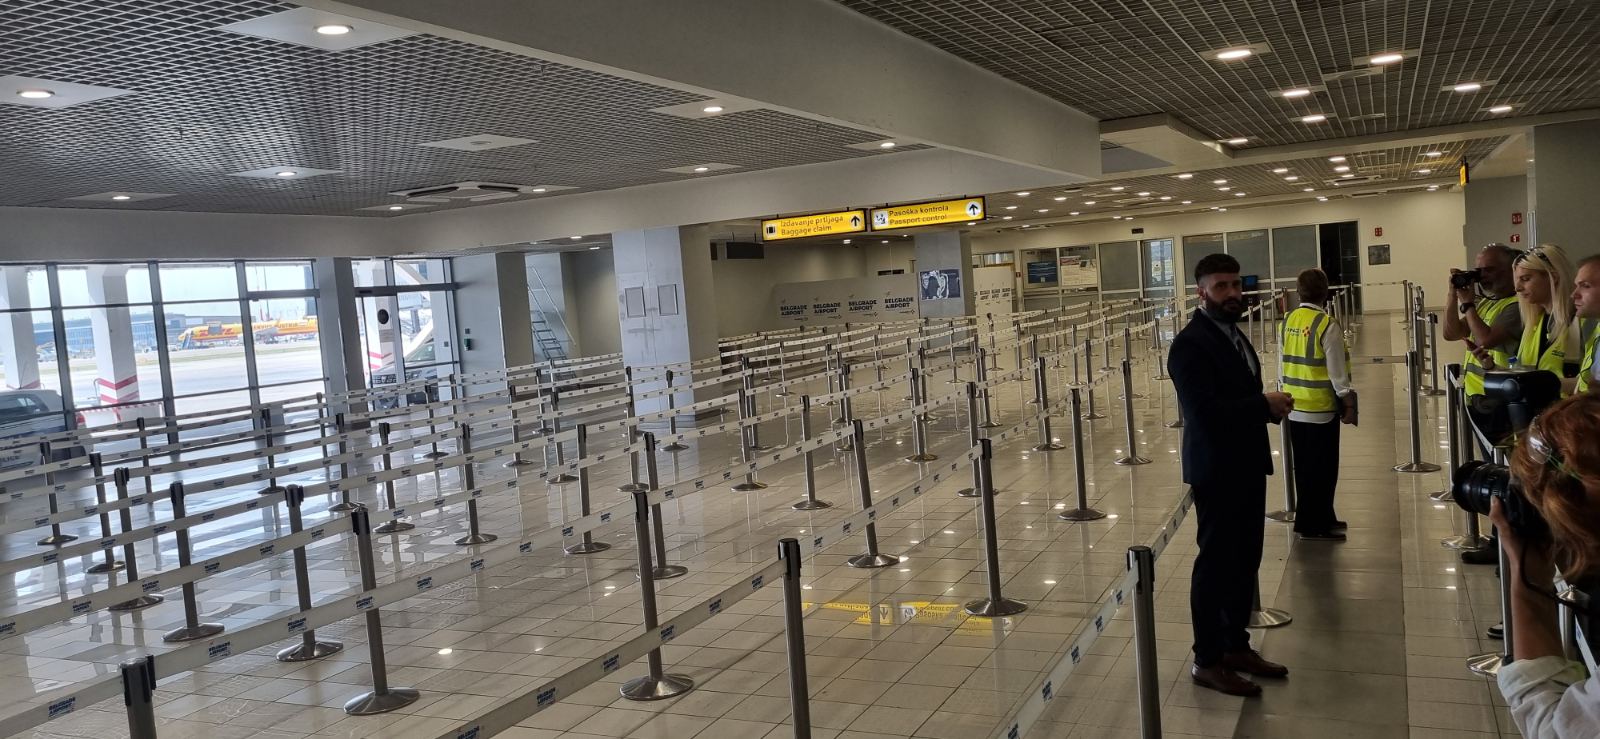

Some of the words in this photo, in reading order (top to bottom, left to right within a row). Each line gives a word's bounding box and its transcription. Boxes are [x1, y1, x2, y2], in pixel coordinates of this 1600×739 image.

[919, 204, 949, 214] kontrola
[780, 218, 814, 227] Izdavanje
[815, 215, 844, 225] prtljaga
[889, 216, 921, 226] Passport
[922, 214, 948, 223] control
[781, 227, 812, 237] Baggage
[813, 224, 833, 232] claim
